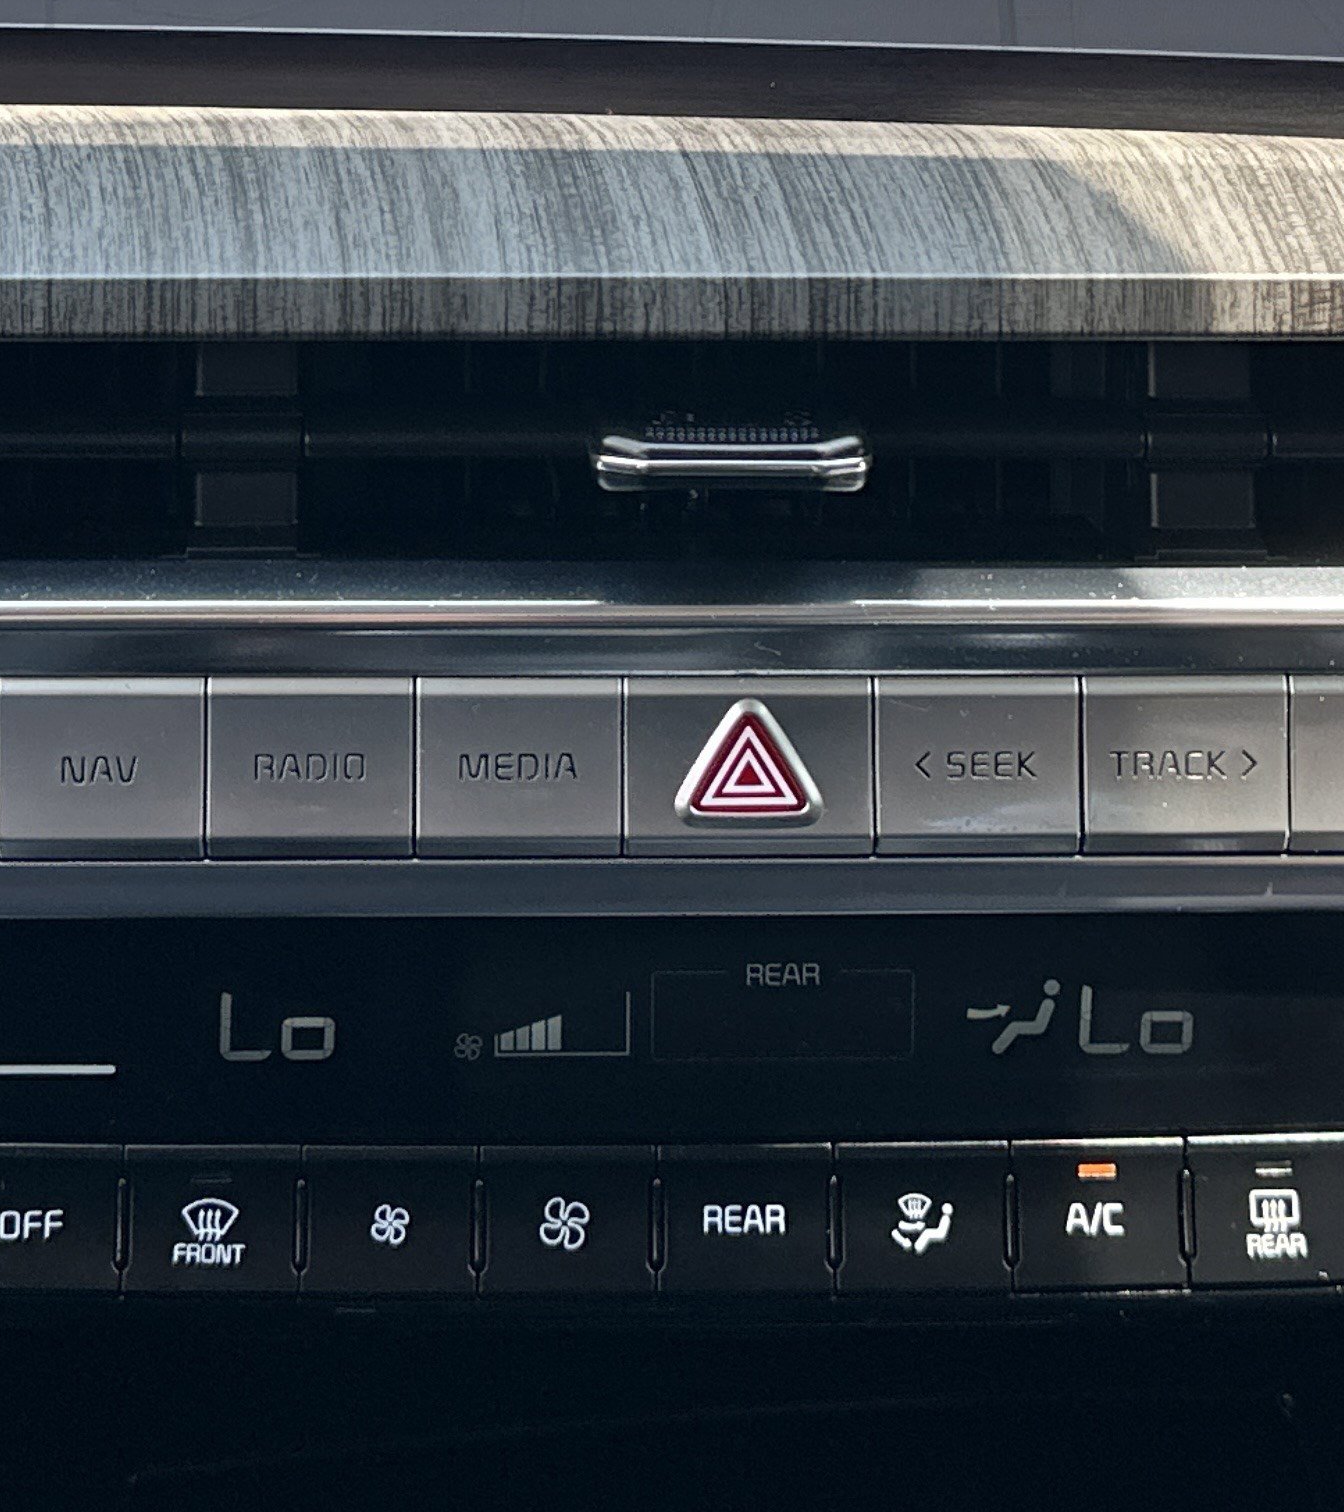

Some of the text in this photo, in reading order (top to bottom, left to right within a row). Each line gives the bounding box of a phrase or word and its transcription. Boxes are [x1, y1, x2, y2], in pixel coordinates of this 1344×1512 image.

[61, 757, 138, 784] NAV
[253, 753, 367, 780] RADIO
[458, 753, 577, 780] MEDIA
[746, 964, 820, 986] REAR
[220, 992, 335, 1060] Lo
[1079, 986, 1192, 1055] Lo
[703, 1205, 785, 1234] REAR
[1067, 1201, 1124, 1236] A/C
[172, 1243, 246, 1266] FRONT
[1247, 1233, 1306, 1257] REAR
